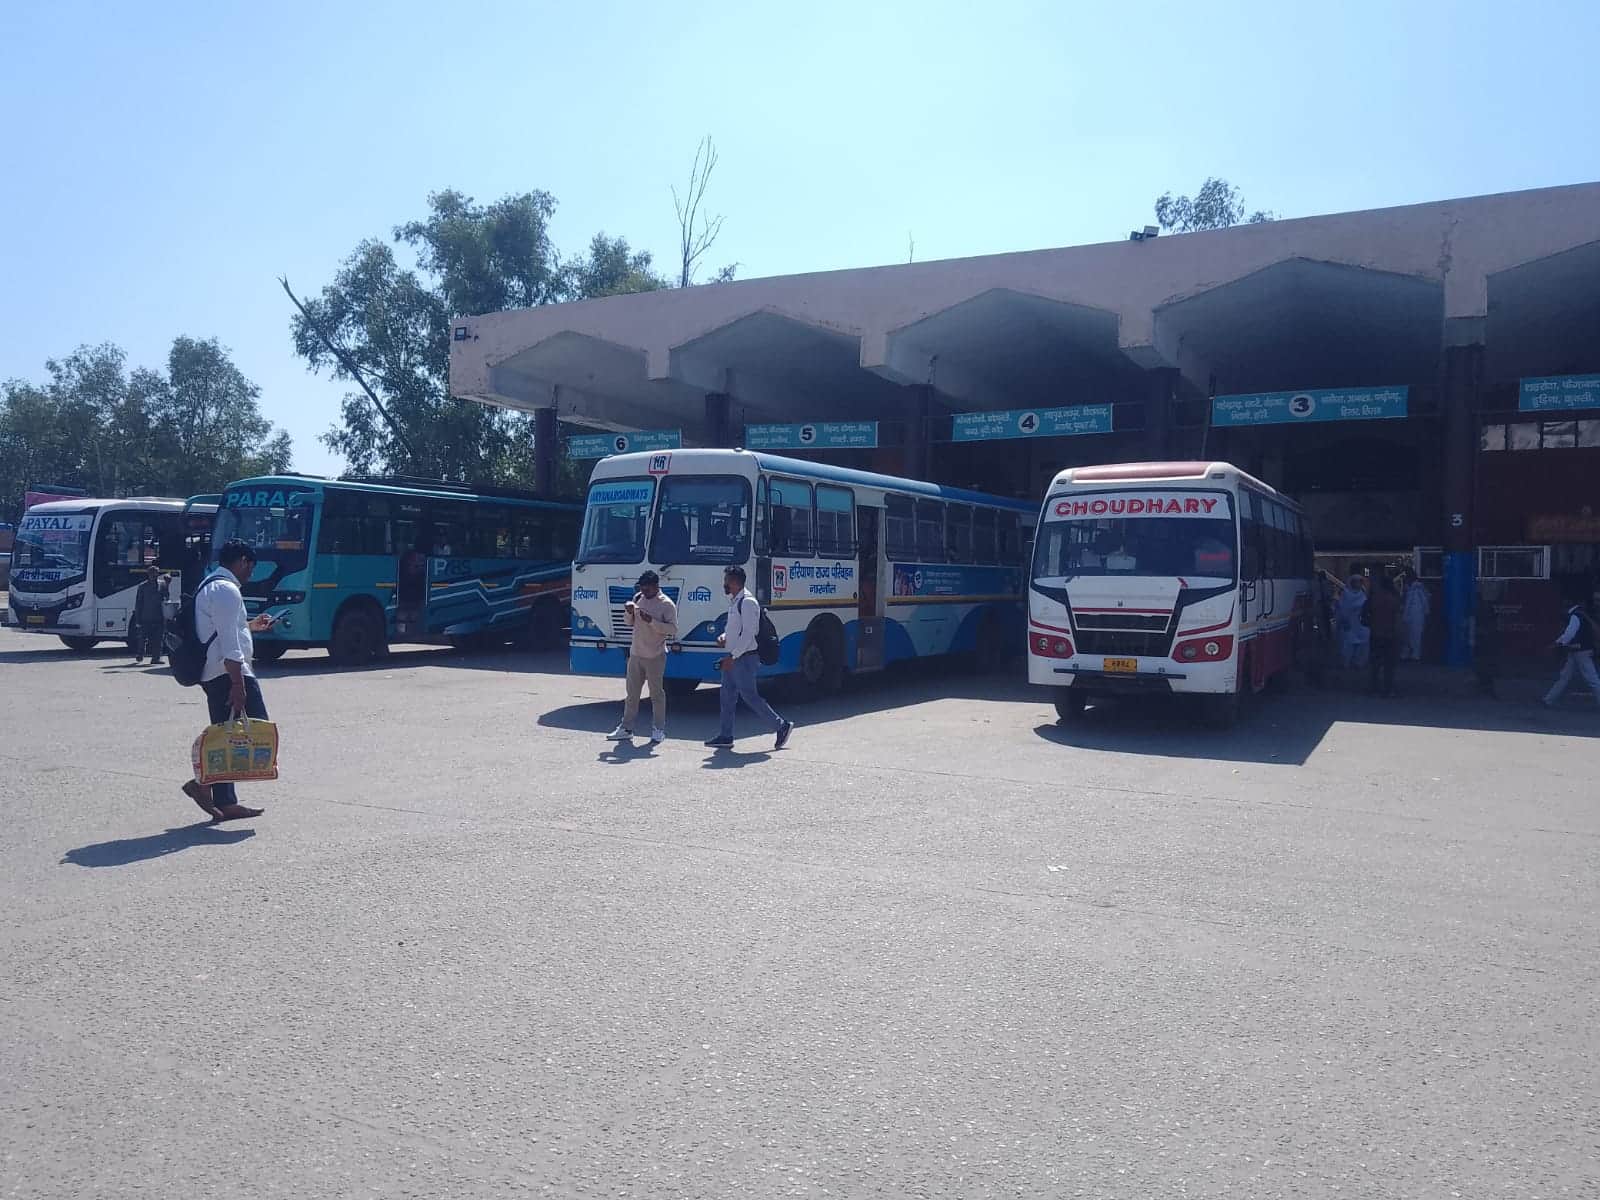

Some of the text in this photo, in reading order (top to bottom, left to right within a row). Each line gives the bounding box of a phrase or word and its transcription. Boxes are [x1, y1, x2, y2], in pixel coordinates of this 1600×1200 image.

[1293, 397, 1310, 413] 3
[1021, 414, 1036, 429] 4
[801, 428, 814, 440] 5
[615, 437, 627, 450] 6
[1054, 498, 1218, 516] CHOUDHARY
[26, 517, 73, 530] PAYAL
[789, 561, 854, 580] हरियाणा राज्य परिवहन
[573, 586, 599, 601] हरियाणा
[687, 586, 712, 602] शक्ति
[808, 582, 837, 594] नारनौल
